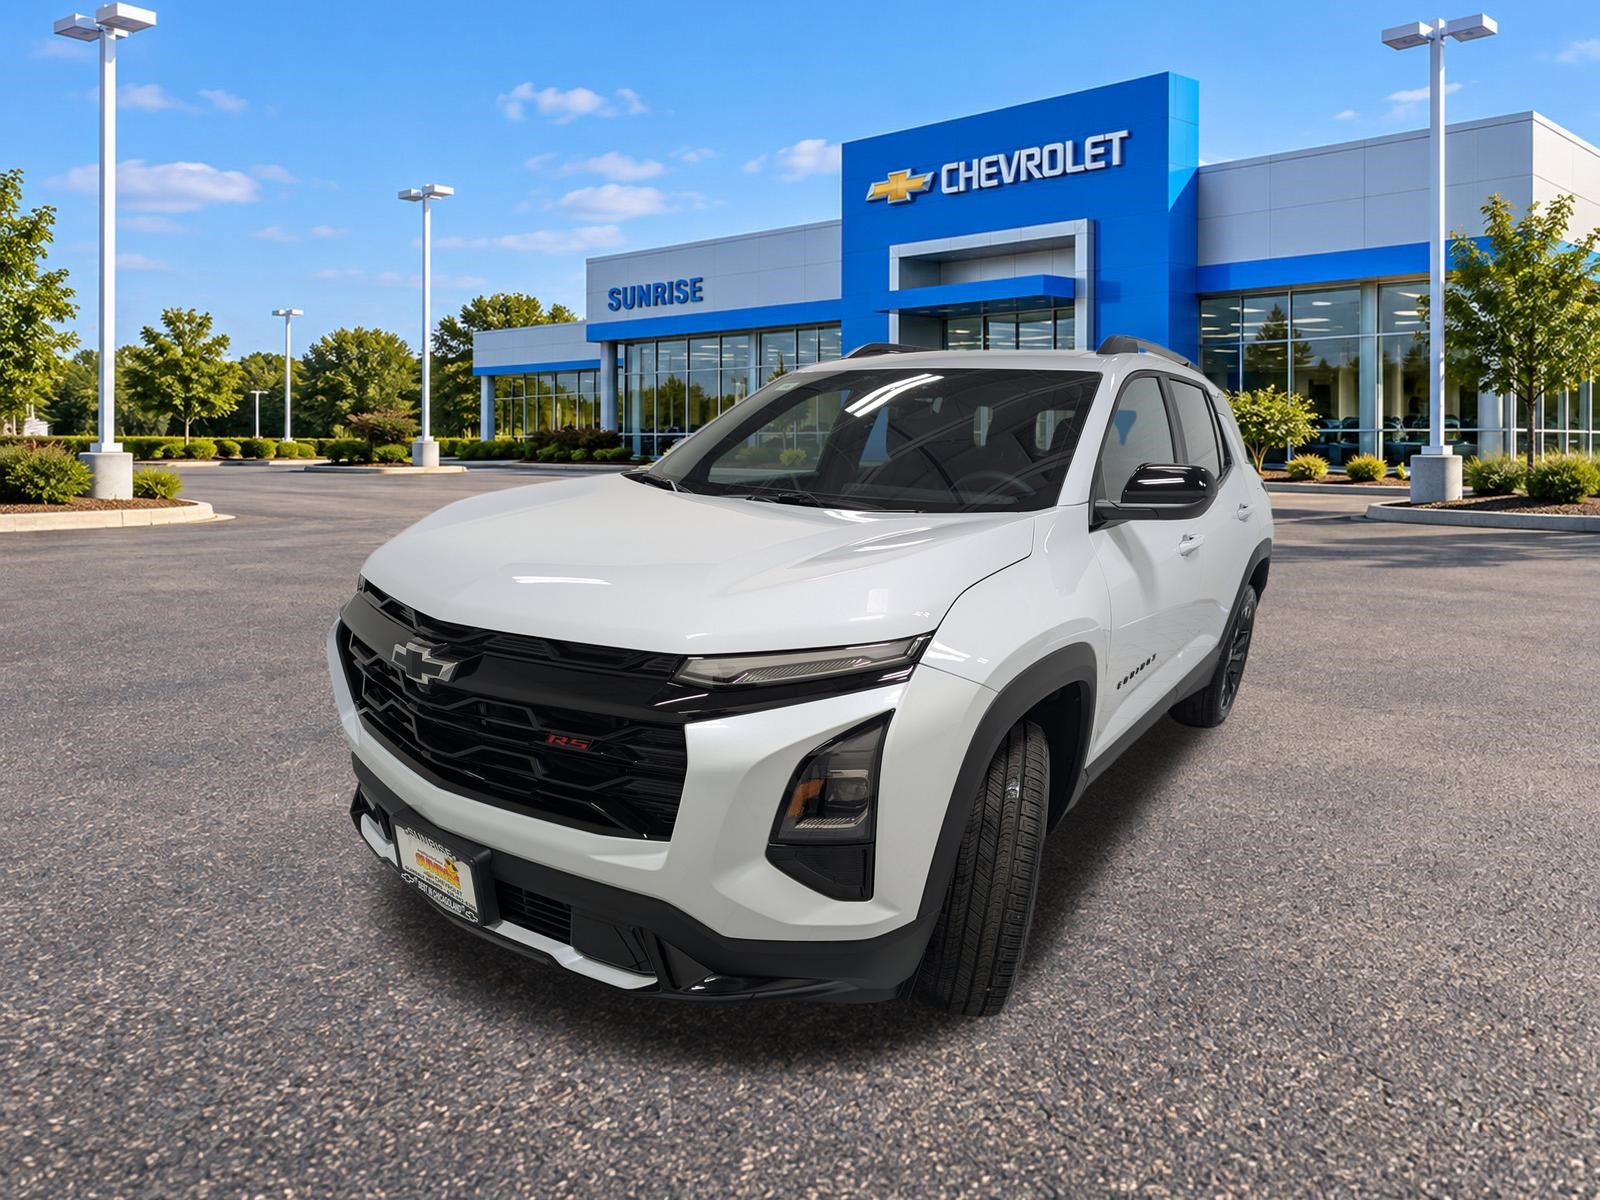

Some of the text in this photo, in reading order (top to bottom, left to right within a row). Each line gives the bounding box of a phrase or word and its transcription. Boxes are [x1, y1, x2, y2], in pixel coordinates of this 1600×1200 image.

[940, 130, 1129, 194] CHEVROLET
[607, 277, 704, 312] SUNRISE
[547, 735, 590, 750] RS
[406, 827, 452, 856] SUNRISE
